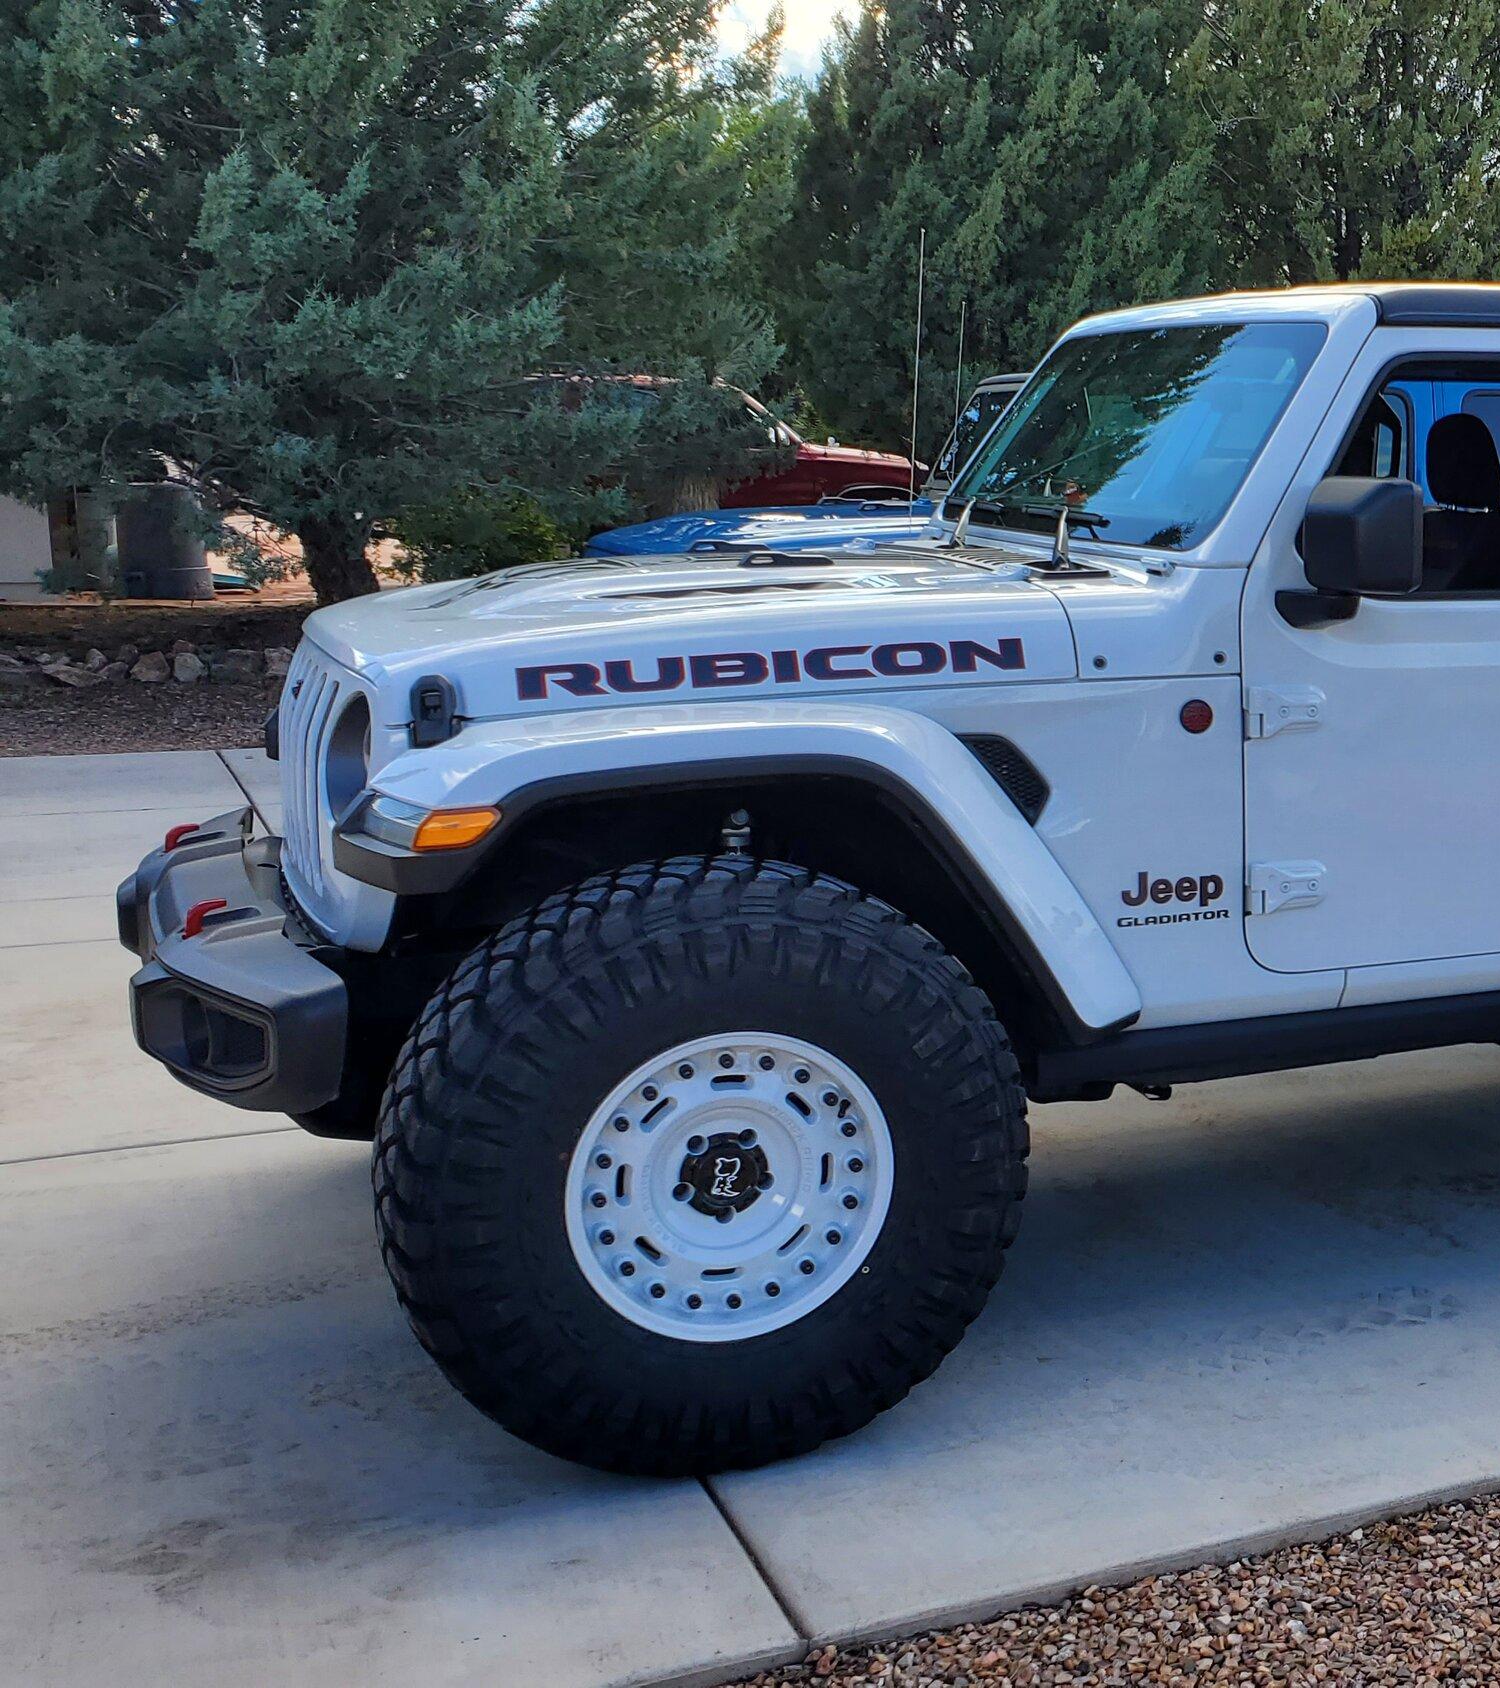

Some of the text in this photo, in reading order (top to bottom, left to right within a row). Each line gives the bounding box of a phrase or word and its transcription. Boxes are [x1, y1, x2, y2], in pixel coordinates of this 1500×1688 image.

[515, 638, 1026, 700] RUBICON
[1121, 871, 1223, 907] Jeep
[1117, 909, 1230, 927] GLADIATOR
